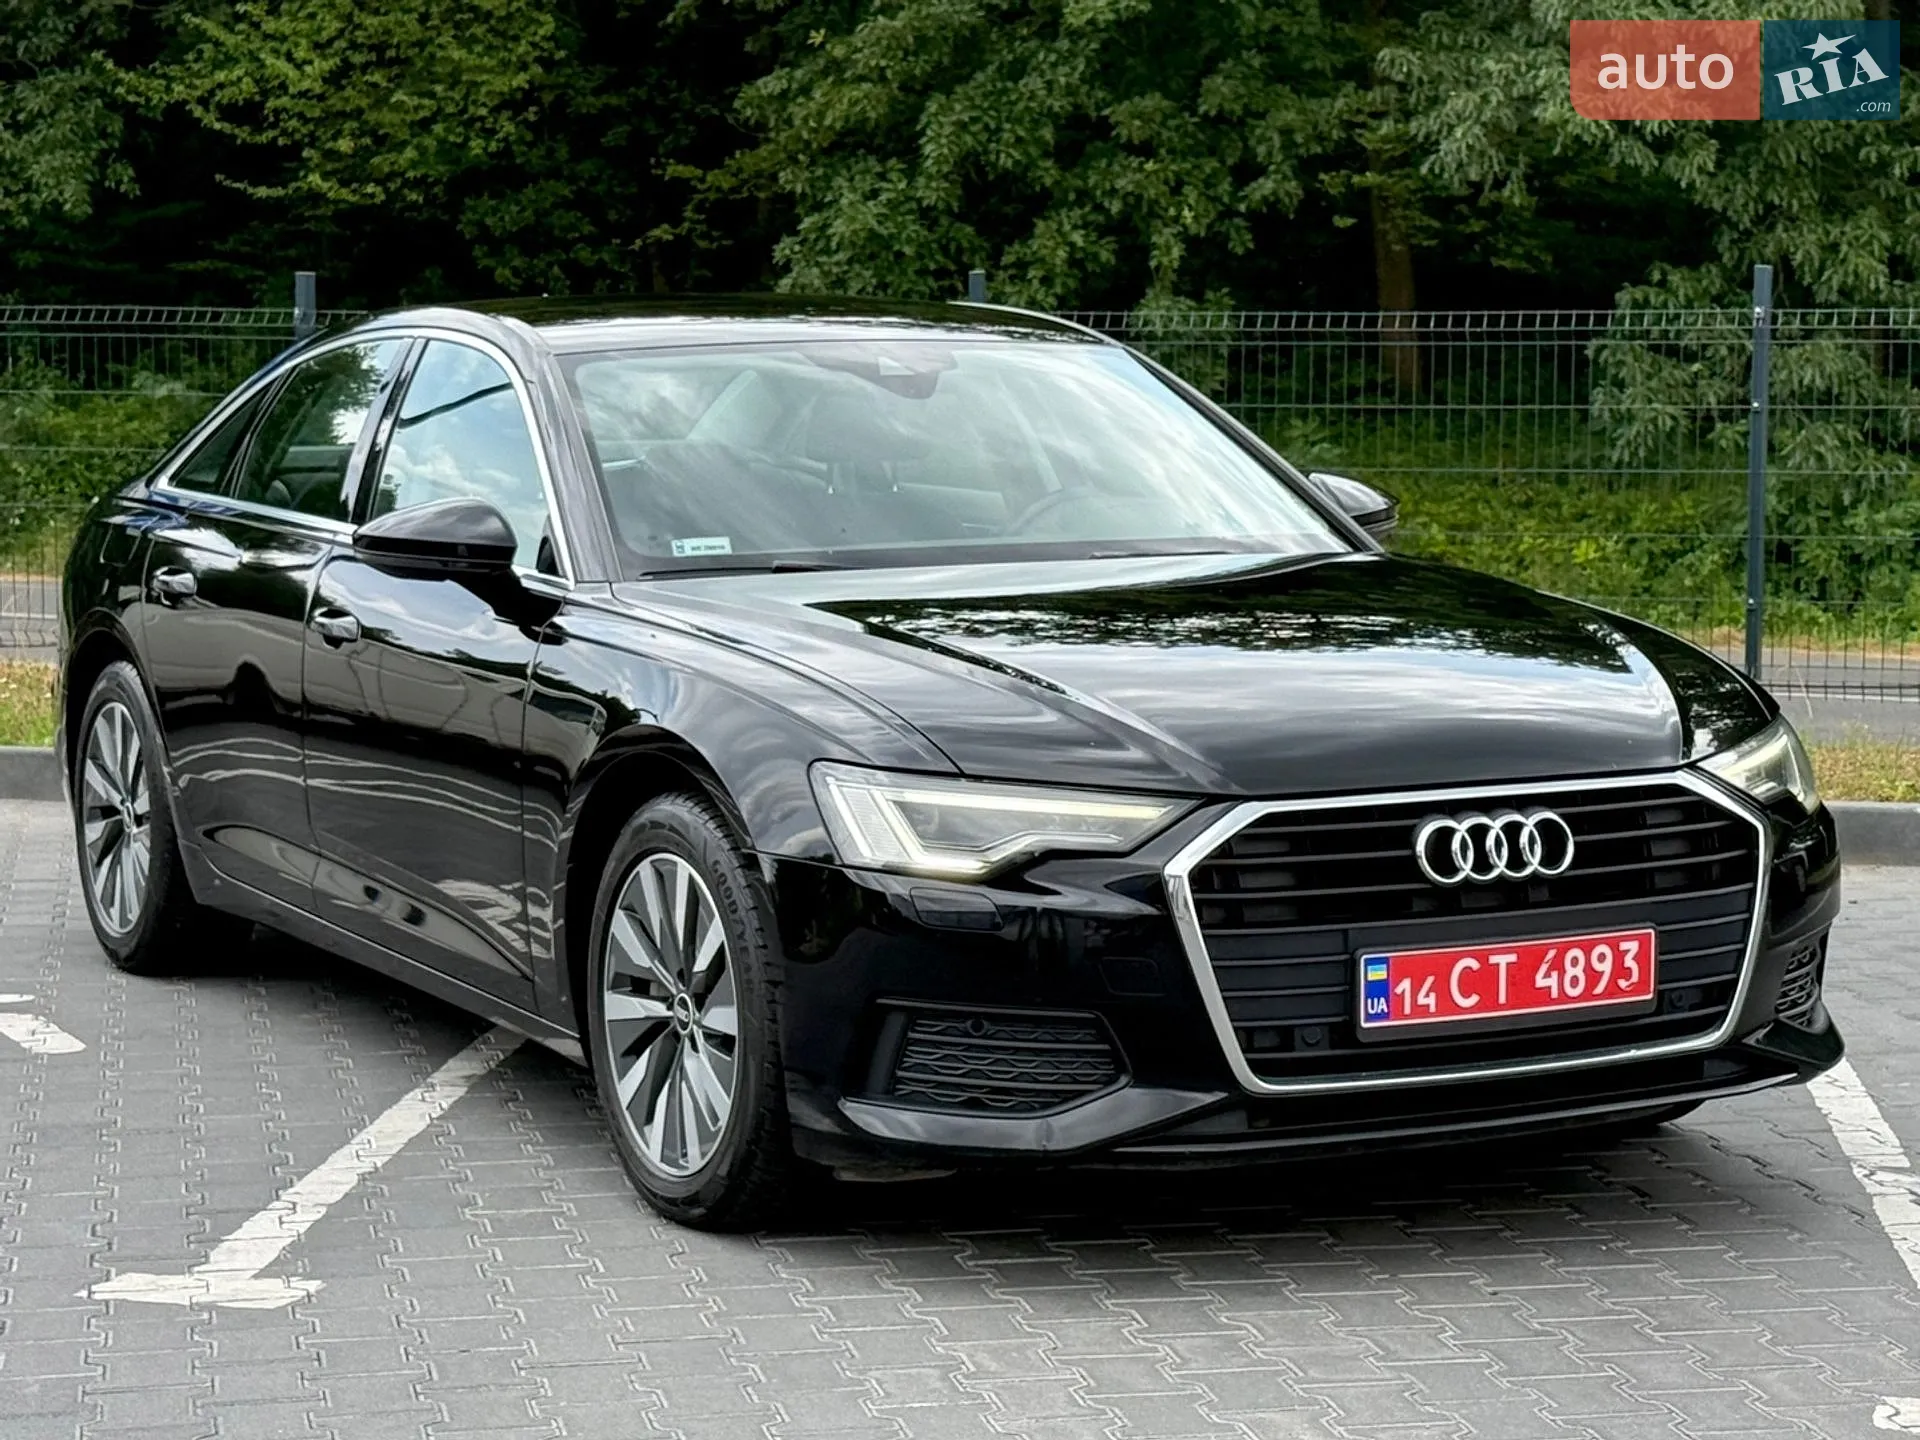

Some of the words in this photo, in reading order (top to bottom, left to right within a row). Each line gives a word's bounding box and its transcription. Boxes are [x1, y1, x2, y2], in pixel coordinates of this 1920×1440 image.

[1394, 975, 1436, 1015] 14
[1450, 953, 1518, 1008] CT
[1535, 940, 1640, 999] 4893
[1367, 997, 1388, 1014] UA
